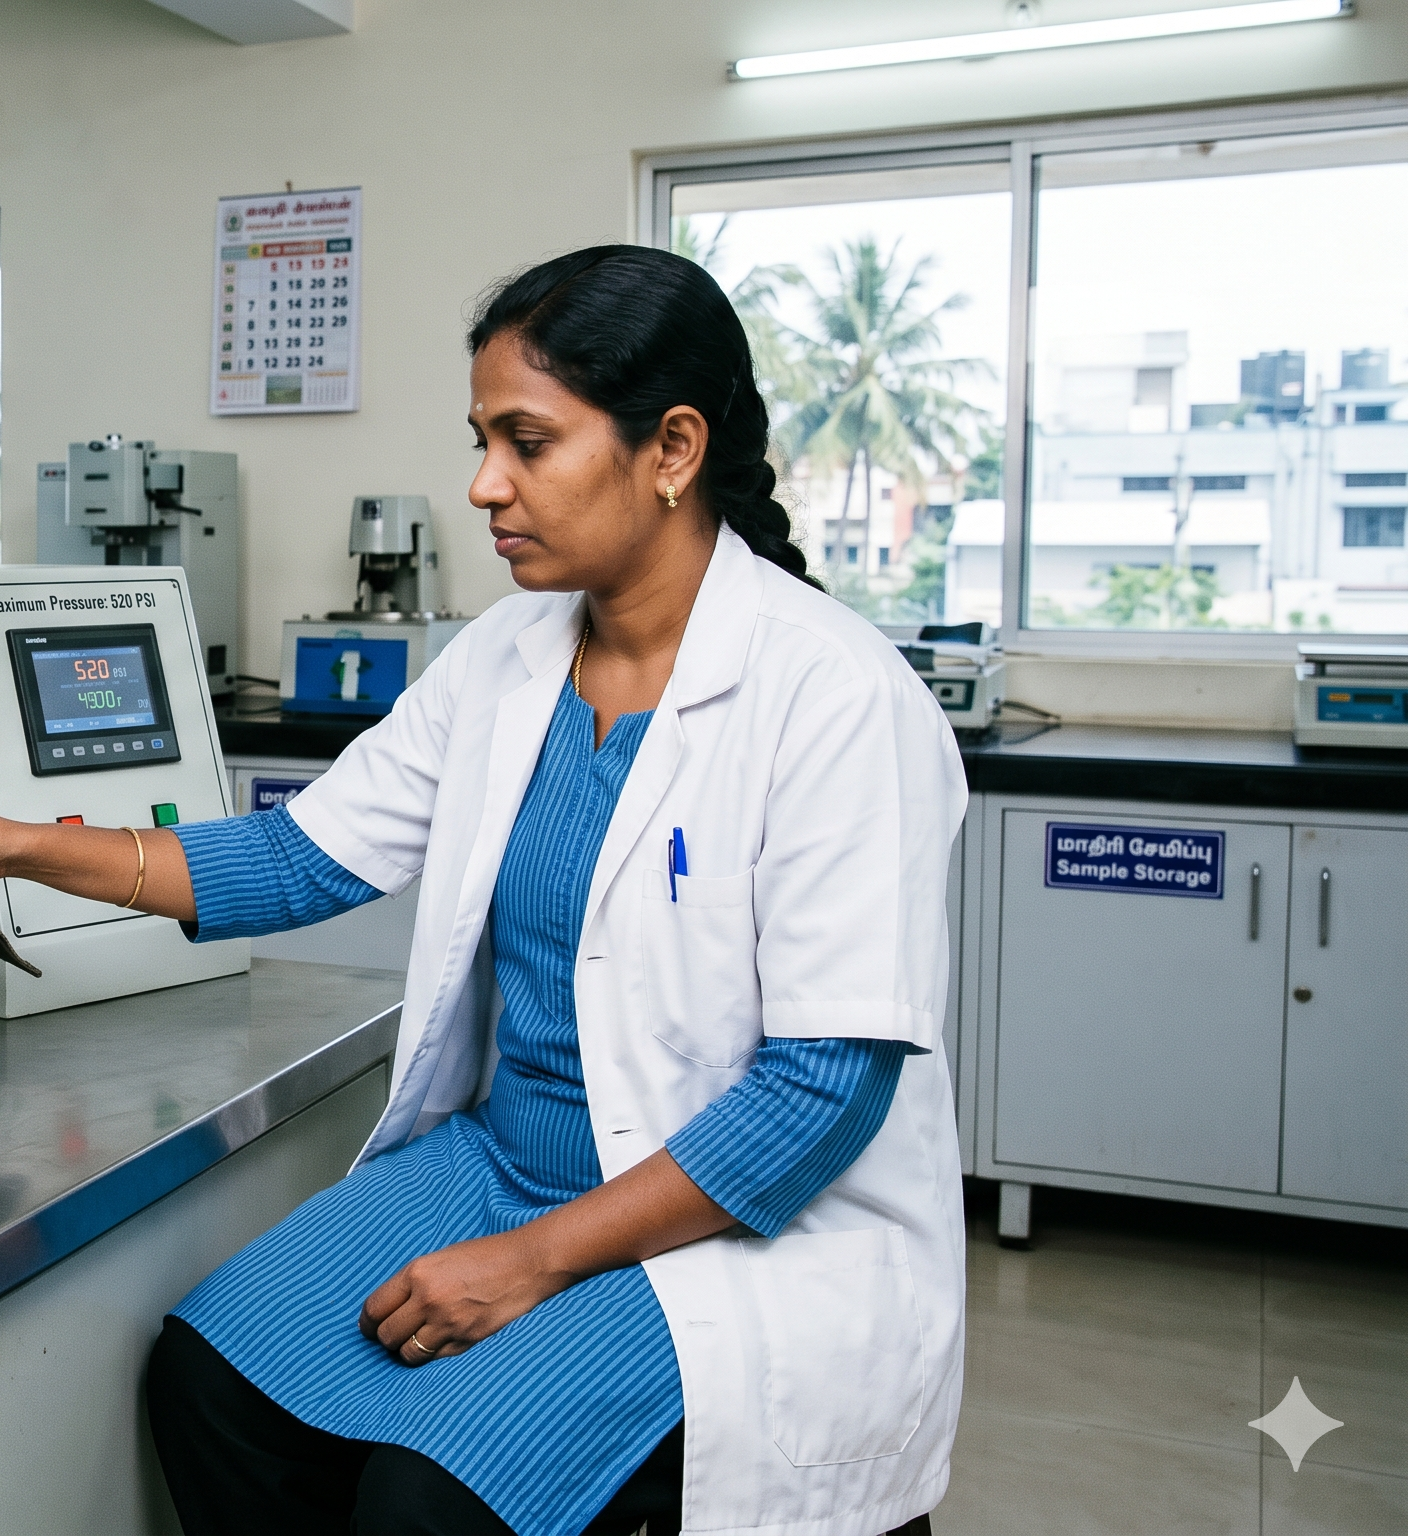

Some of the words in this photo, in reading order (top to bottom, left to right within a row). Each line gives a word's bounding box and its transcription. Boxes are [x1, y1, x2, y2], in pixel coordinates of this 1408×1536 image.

[49, 595, 108, 611] Pressure:
[110, 593, 133, 609] 520
[135, 592, 156, 608] PSI
[74, 659, 110, 680] 520
[1057, 834, 1125, 858] மாதிரி
[1129, 837, 1212, 866] சேமிப்பு
[1056, 858, 1129, 881] Sample
[1134, 863, 1212, 888] Storage
